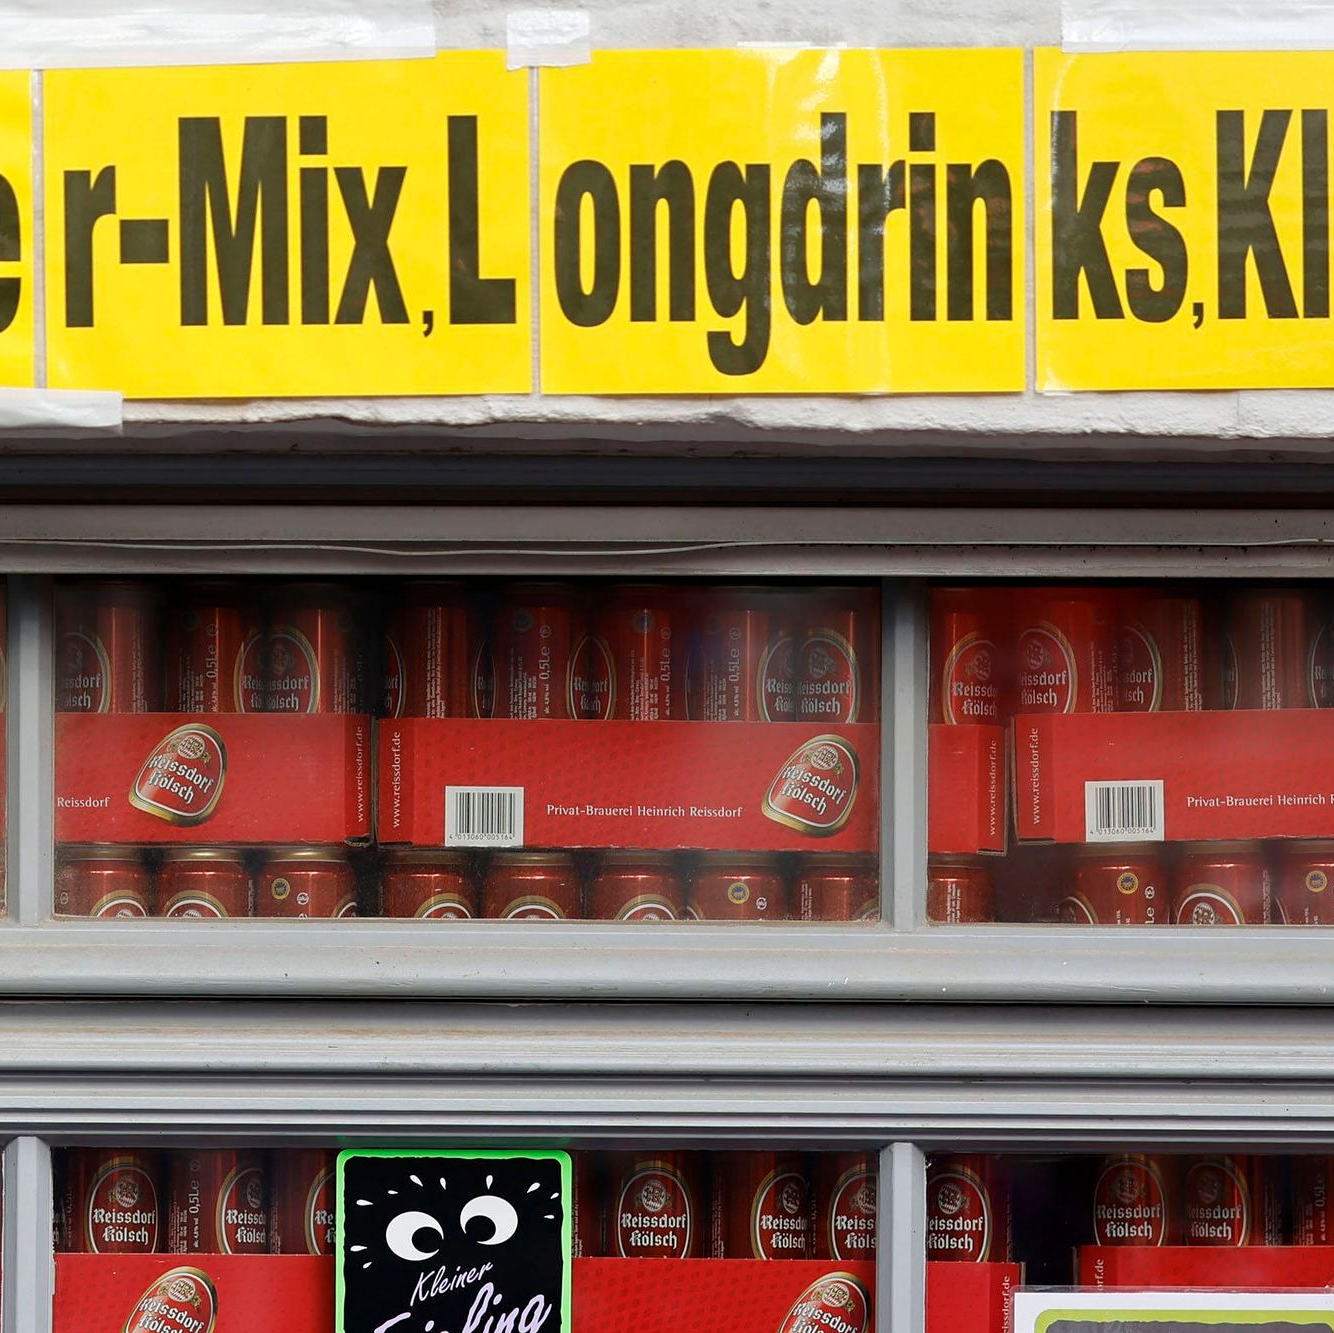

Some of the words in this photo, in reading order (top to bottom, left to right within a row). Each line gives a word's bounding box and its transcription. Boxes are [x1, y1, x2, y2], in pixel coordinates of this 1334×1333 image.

[149, 752, 214, 791] Reissdorf
[393, 731, 401, 828] www.reissdorf.de
[781, 765, 847, 804] Reissdorf
[1030, 728, 1040, 825] www.reissdorf.de
[147, 771, 194, 804] Kölsch
[781, 783, 828, 815] Kölsch
[989, 740, 998, 836] www.reissdorf.de
[1186, 793, 1275, 808] Privat-Brauerei
[1277, 793, 1326, 808] Heinrich
[57, 796, 110, 808] Reissdorf
[547, 804, 633, 818] Privat-Brauerei
[638, 804, 684, 818] Heinrich
[690, 804, 743, 818] Reissdorf
[93, 1208, 156, 1224] Reissdorf
[622, 1212, 687, 1229] Reissdorf
[1096, 1205, 1163, 1224] Reissdorf
[102, 1225, 149, 1245] Kölsch
[630, 1230, 677, 1250] Kölsch
[1106, 1221, 1154, 1240] Kölsch
[410, 1261, 493, 1307] Kleiner
[140, 1296, 205, 1333] Reissdorf
